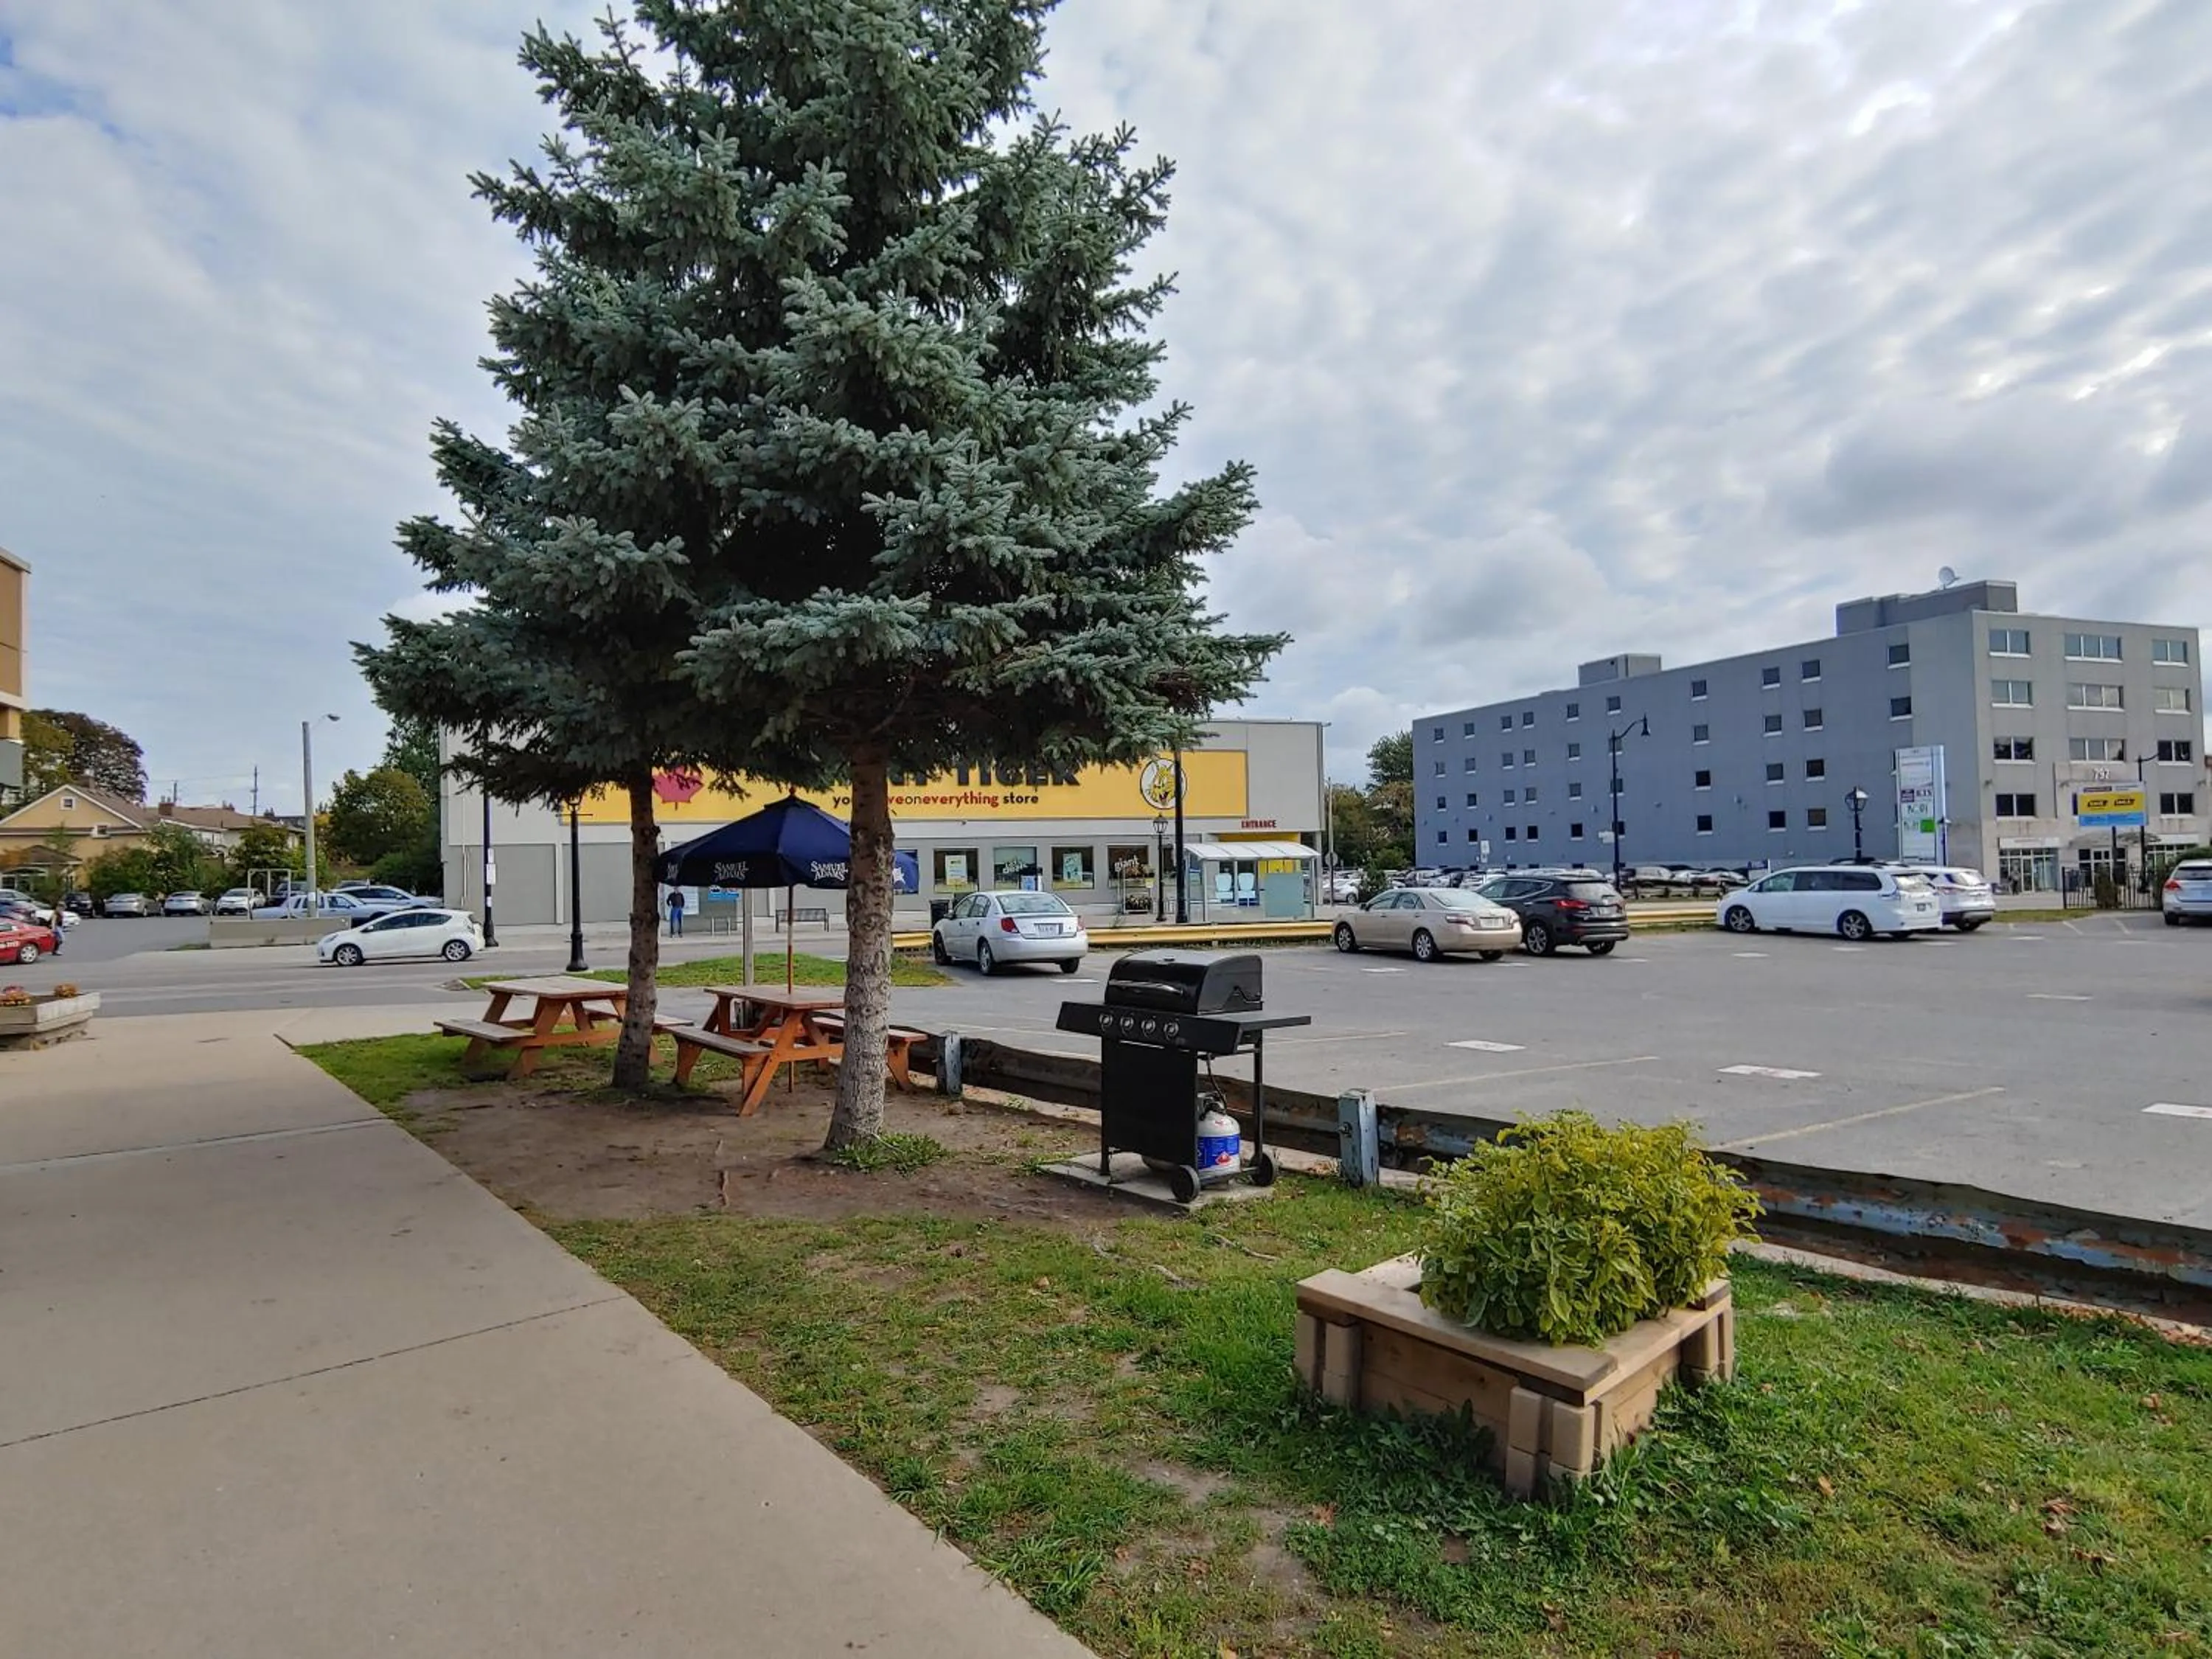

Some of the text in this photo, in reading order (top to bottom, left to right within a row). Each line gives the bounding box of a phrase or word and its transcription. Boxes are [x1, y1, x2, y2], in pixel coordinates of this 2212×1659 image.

[2095, 768, 2110, 779] 792
[1004, 792, 1039, 804] store
[1241, 819, 1277, 828] ENTRANCE
[714, 860, 749, 873] SAMUEL
[810, 860, 849, 874] SAMUEL
[713, 869, 746, 883] ADAMS
[814, 870, 846, 881] ADAMS
